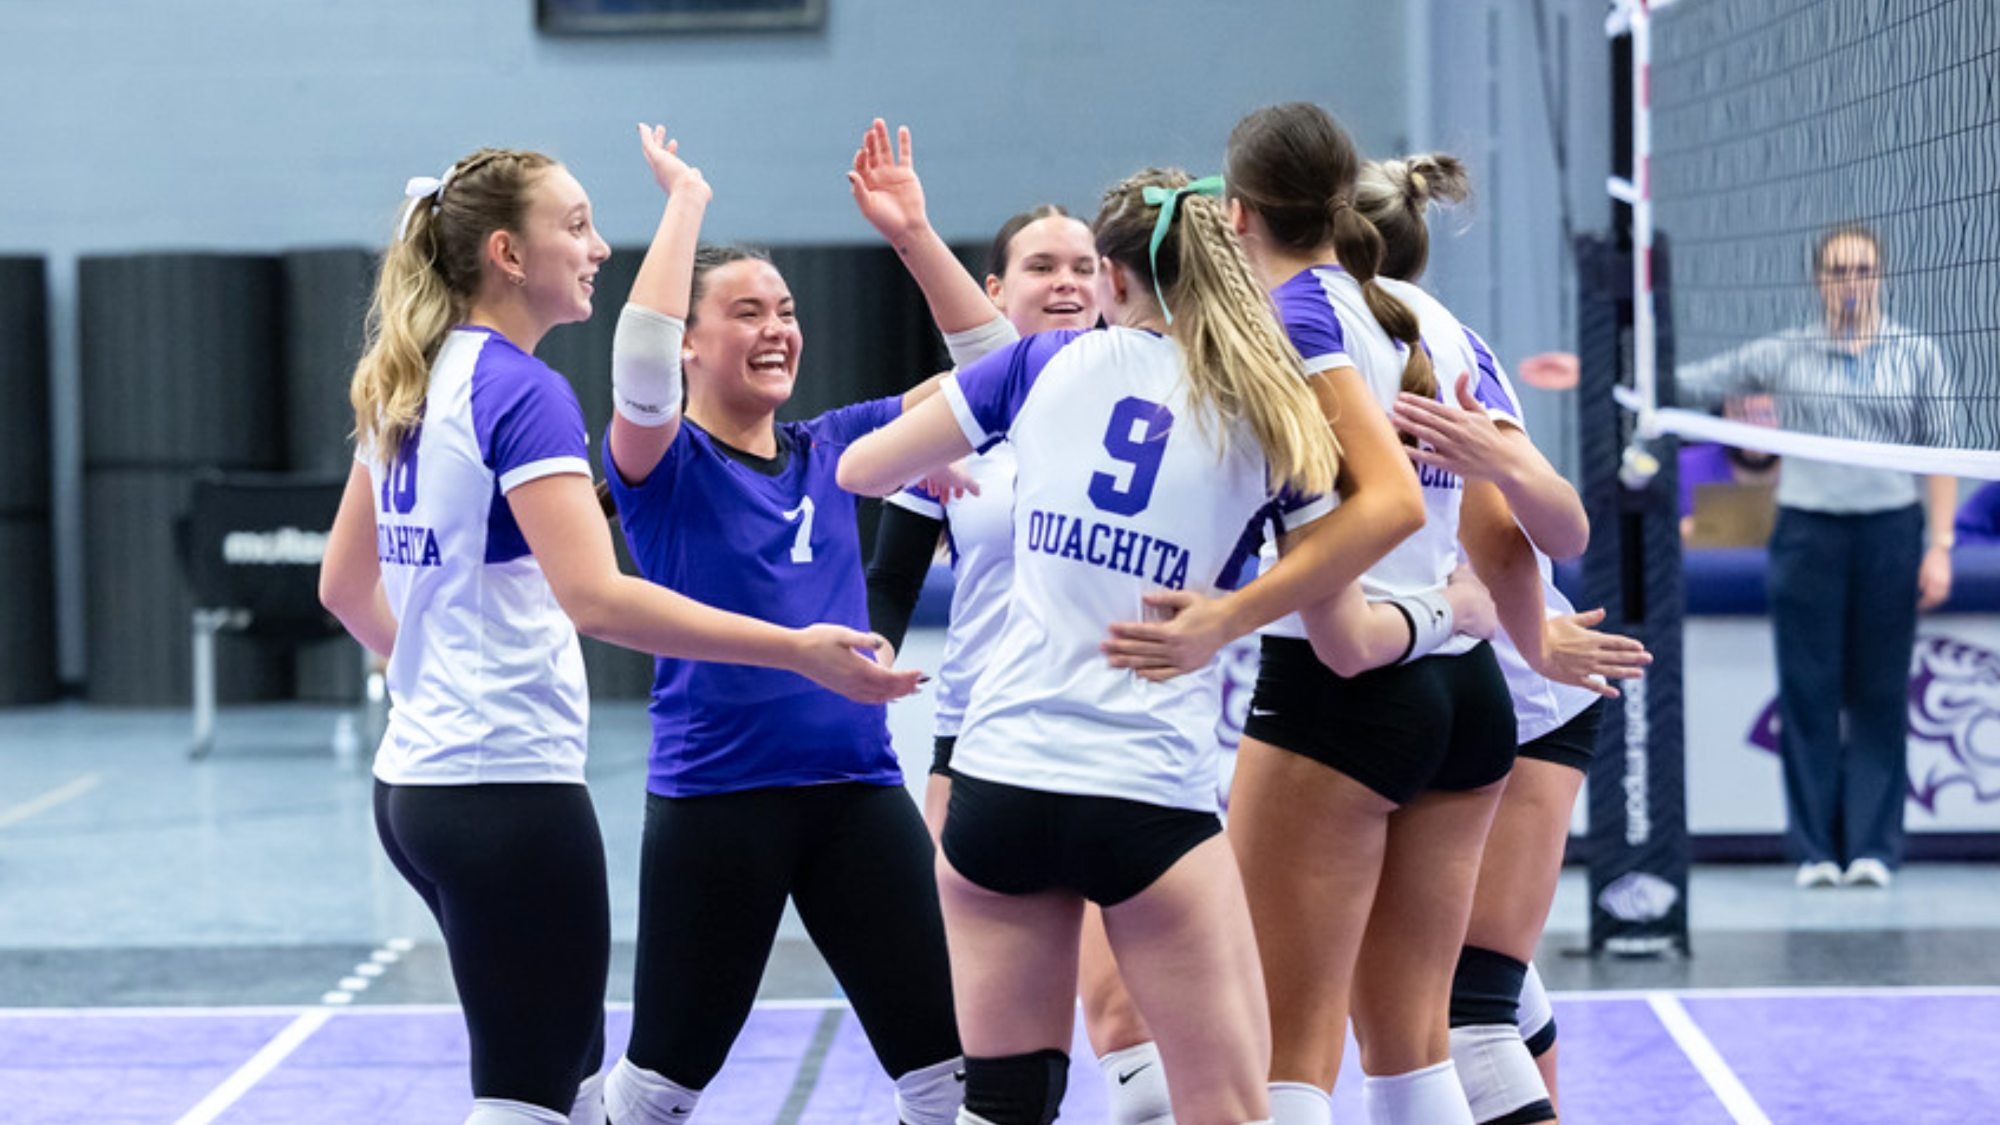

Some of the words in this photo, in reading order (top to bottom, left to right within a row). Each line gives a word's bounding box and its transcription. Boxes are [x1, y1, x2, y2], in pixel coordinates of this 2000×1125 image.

[1087, 396, 1175, 517] 9
[782, 494, 815, 563] 7
[1028, 510, 1190, 591] OUACHITA
